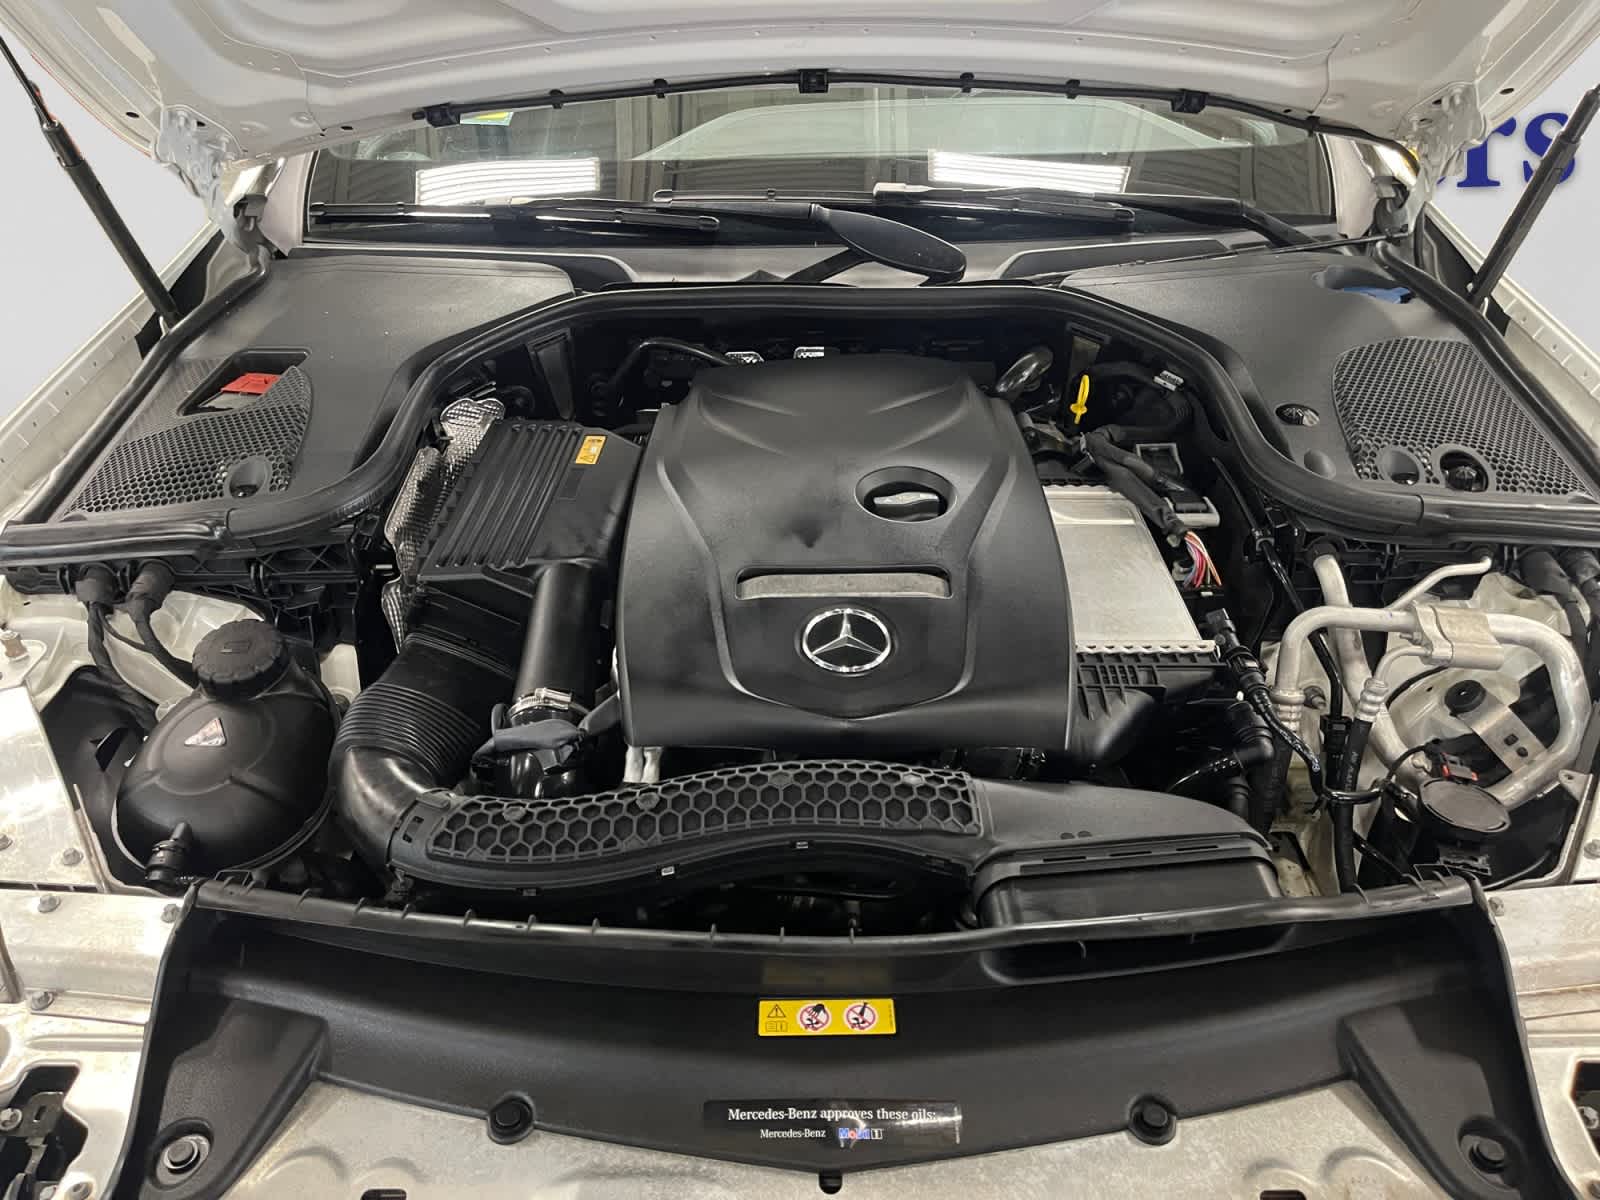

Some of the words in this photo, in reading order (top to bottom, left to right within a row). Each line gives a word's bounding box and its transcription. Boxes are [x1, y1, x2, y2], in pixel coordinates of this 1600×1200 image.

[1437, 112, 1576, 188] rs
[728, 1107, 817, 1121] Mercedes-Benz
[820, 1109, 873, 1122] approves
[876, 1107, 909, 1120] these
[912, 1108, 937, 1122] oils:
[760, 1128, 827, 1139] Mercedes-Benz
